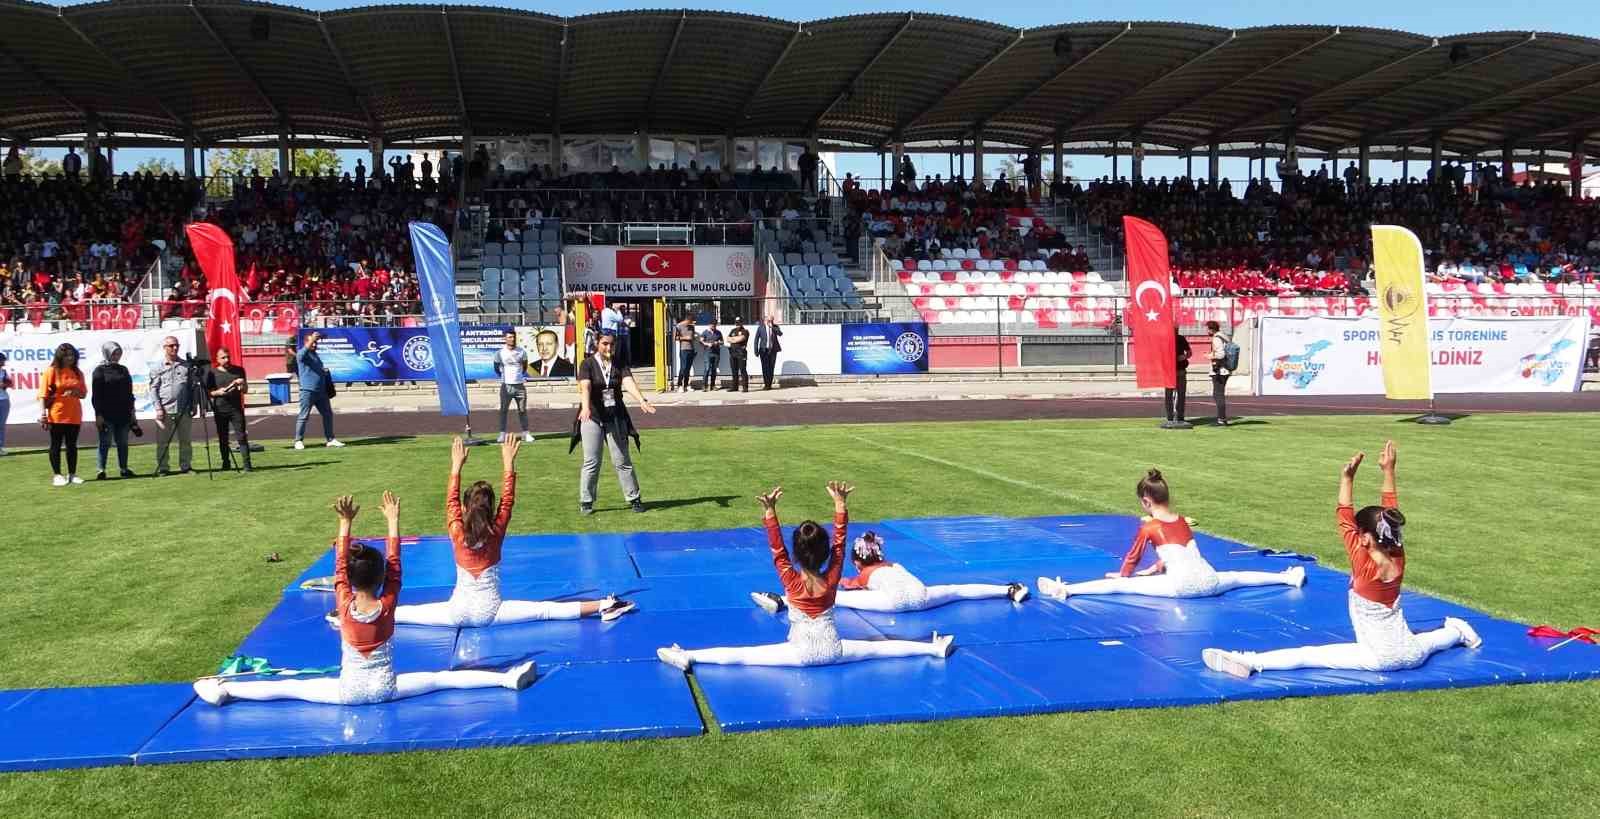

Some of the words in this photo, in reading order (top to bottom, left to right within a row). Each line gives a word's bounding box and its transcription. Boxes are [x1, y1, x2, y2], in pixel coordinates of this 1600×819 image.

[569, 283, 589, 292] VAN
[591, 281, 633, 294] GENÇLİK
[637, 283, 649, 292] VE
[651, 283, 676, 292] SPOR
[679, 281, 688, 292] İL
[690, 281, 751, 292] MÜDÜRLÜĞÜ
